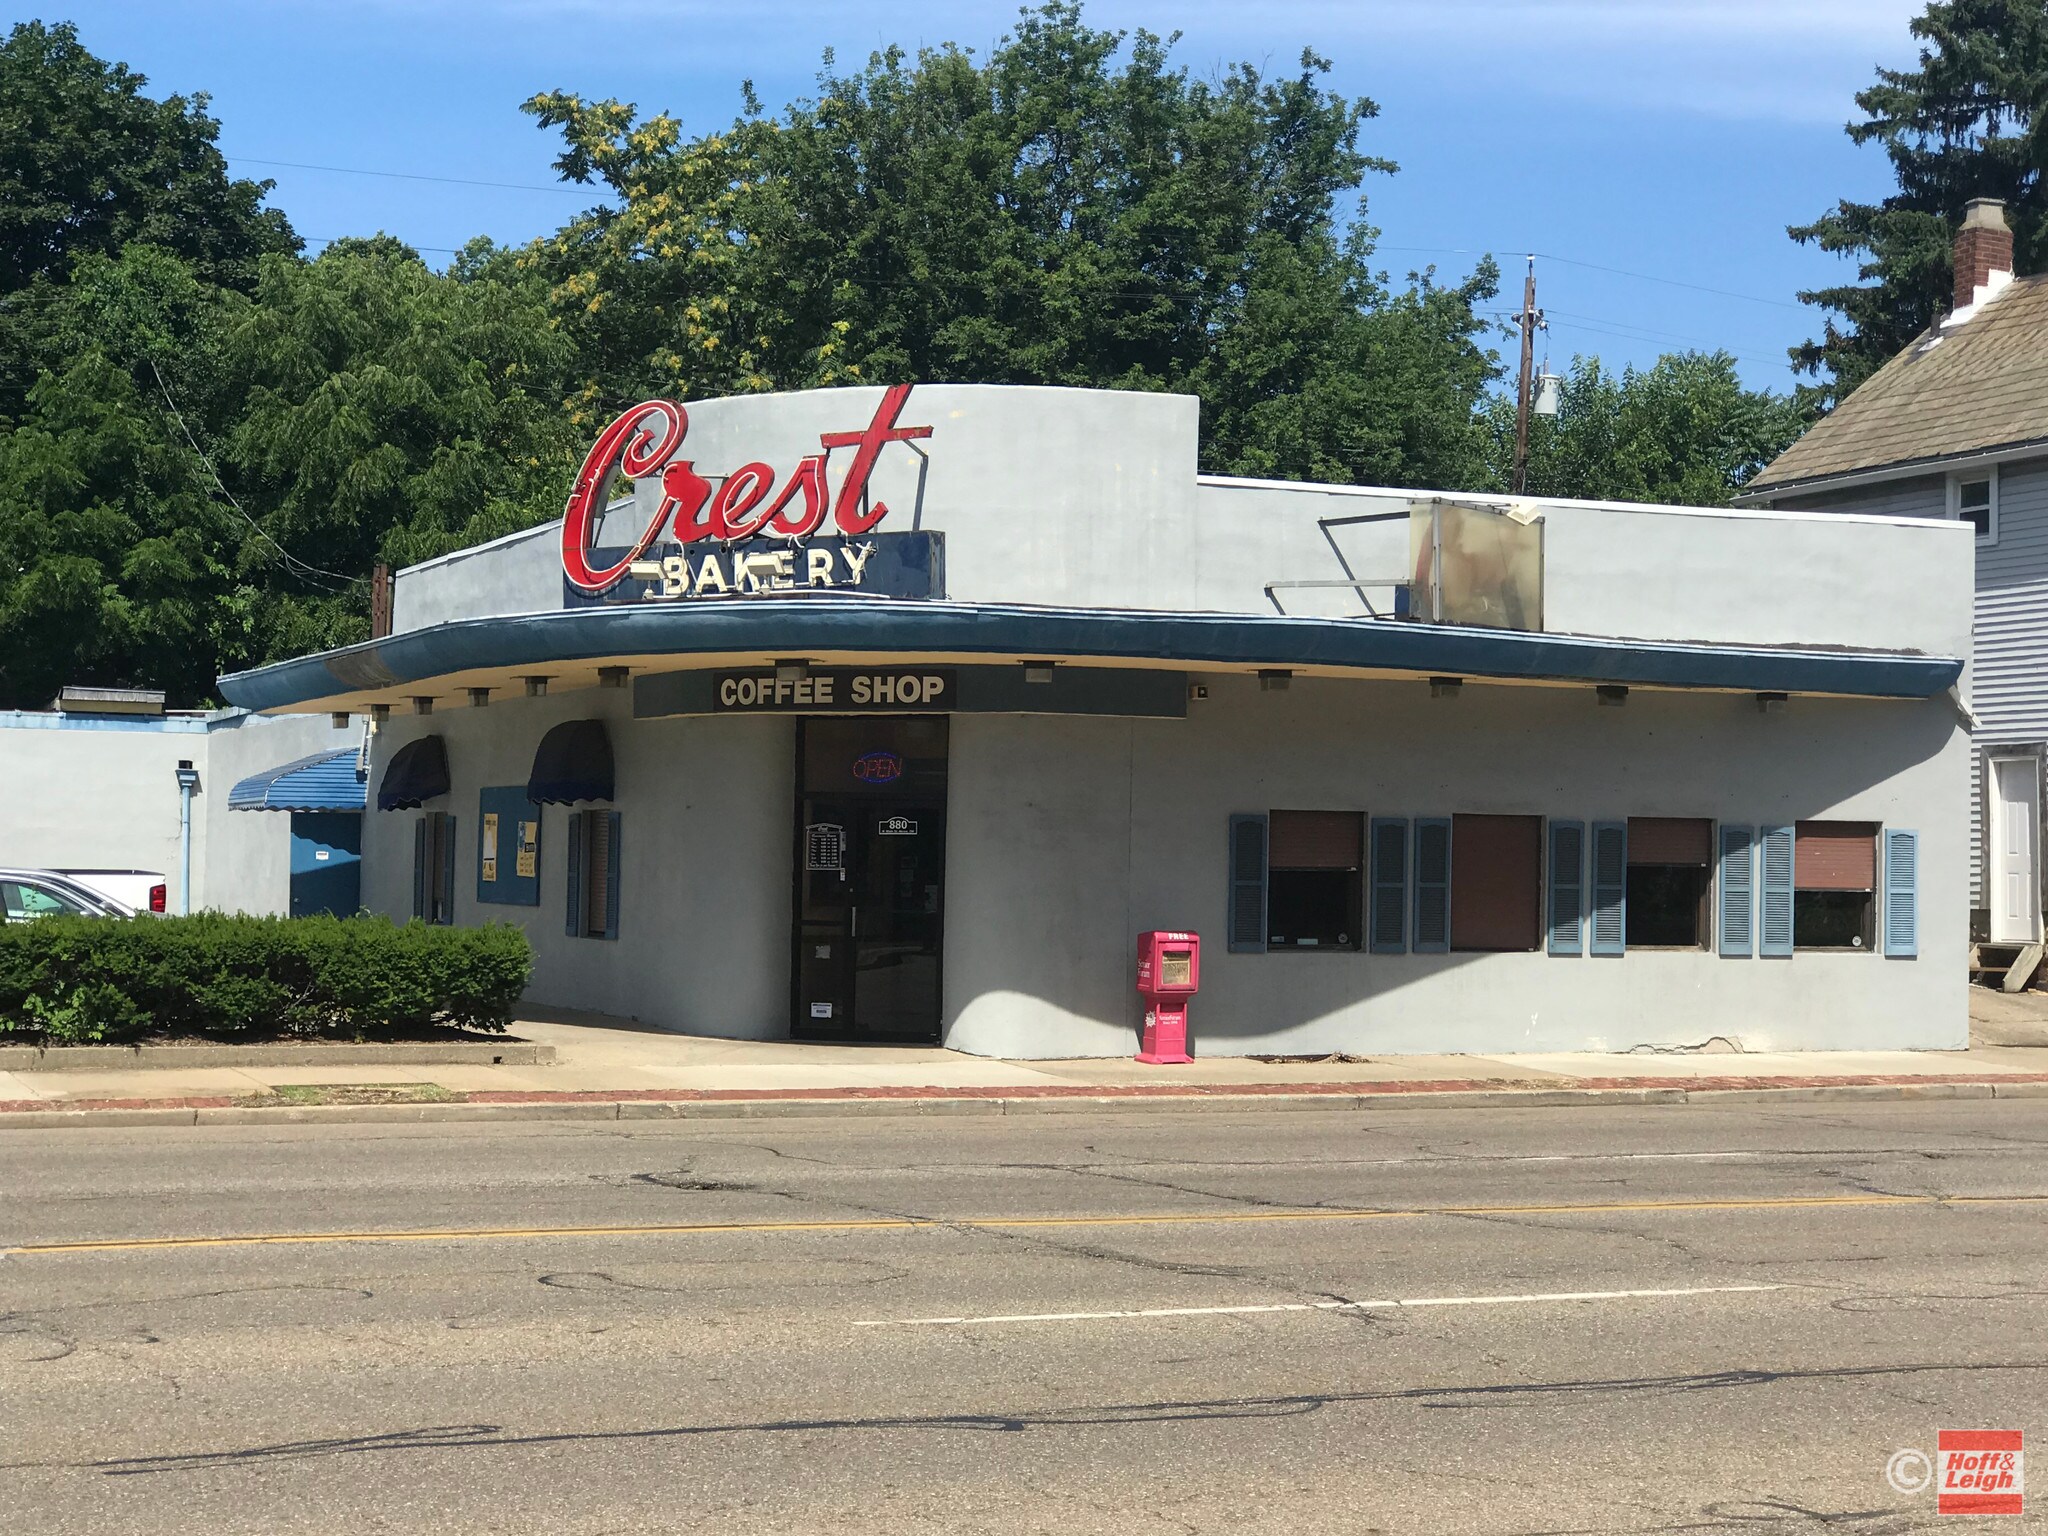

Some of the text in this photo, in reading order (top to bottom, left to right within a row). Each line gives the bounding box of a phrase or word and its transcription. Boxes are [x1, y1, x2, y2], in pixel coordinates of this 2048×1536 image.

[561, 383, 934, 592] Crest
[664, 545, 870, 594] BAKERY
[720, 675, 945, 706] COFFEE SHOP
[853, 758, 902, 778] OPEN
[889, 820, 908, 830] 880
[1168, 932, 1189, 940] FREE
